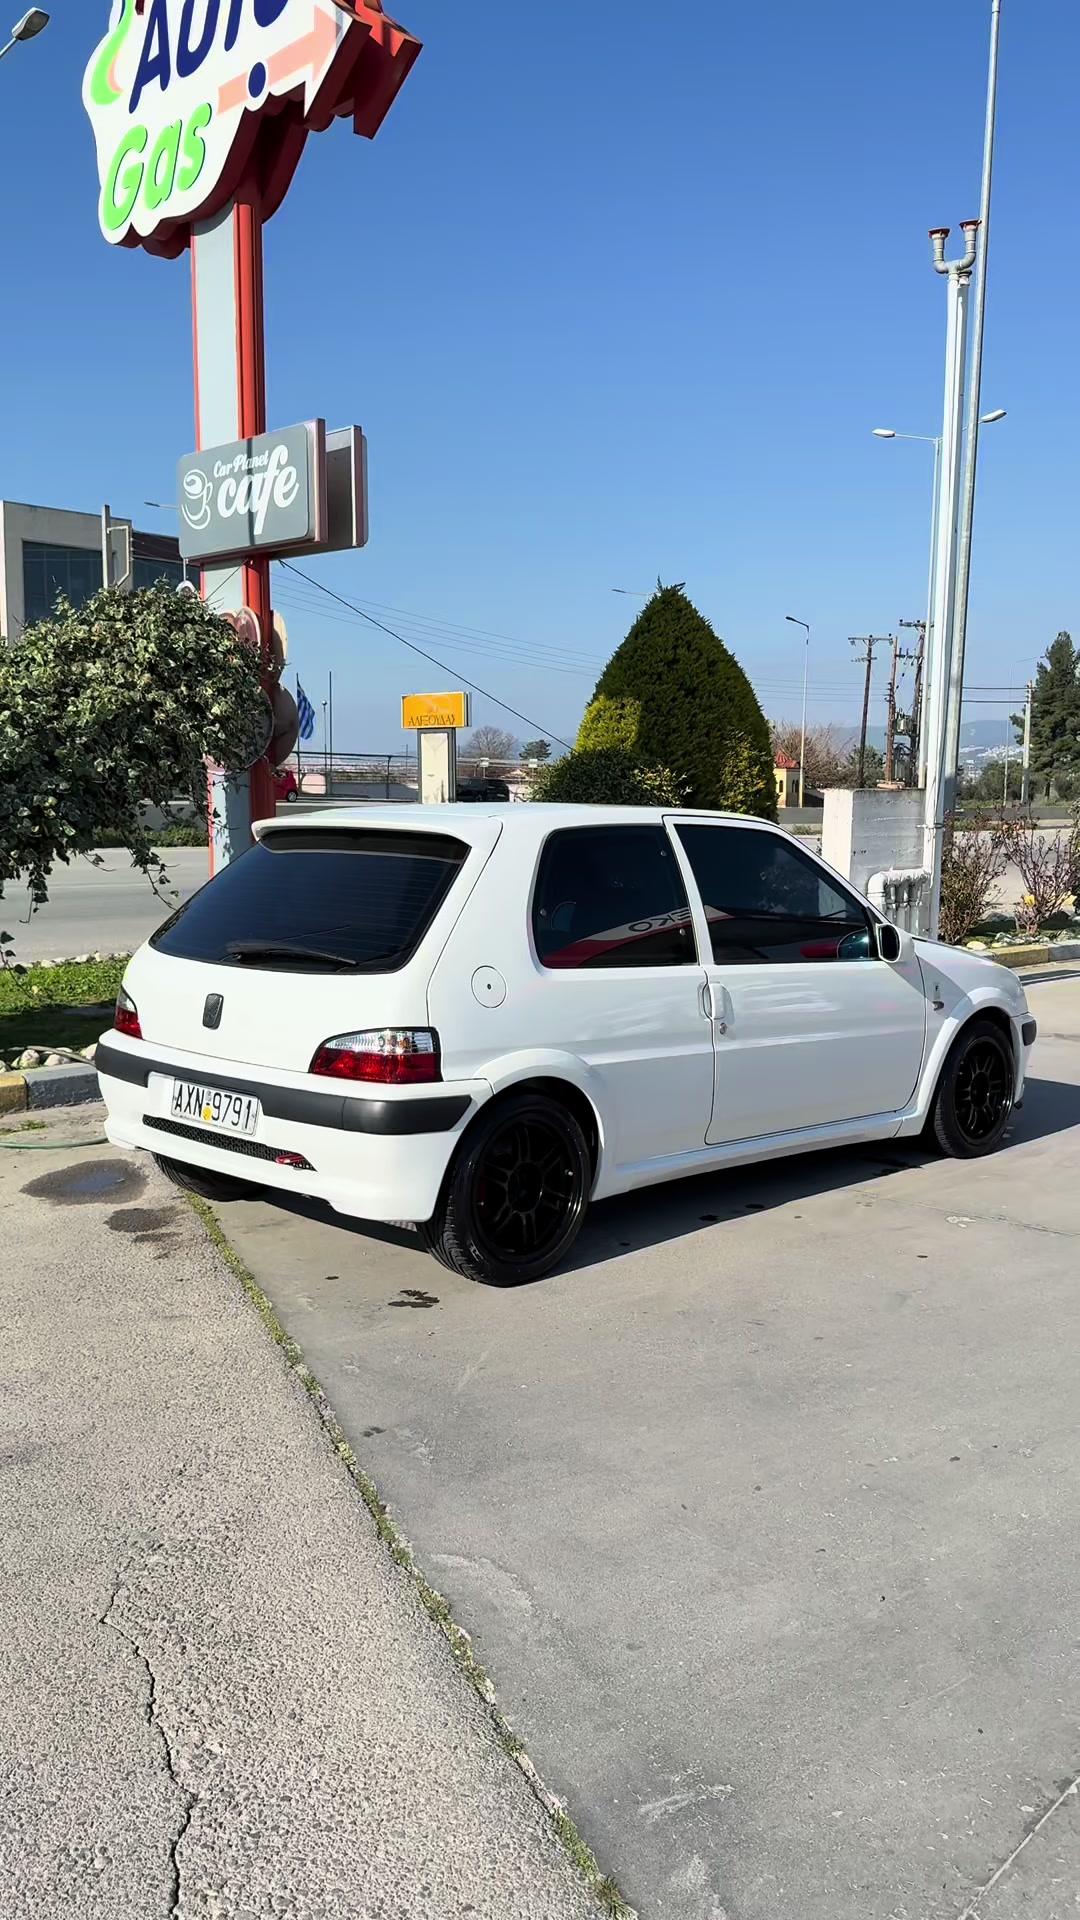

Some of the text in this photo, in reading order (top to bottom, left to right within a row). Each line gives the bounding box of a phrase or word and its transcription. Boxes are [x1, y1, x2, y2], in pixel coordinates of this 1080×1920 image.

[103, 102, 212, 230] Gas
[213, 450, 270, 478] Car Planet
[217, 445, 299, 535] cafe
